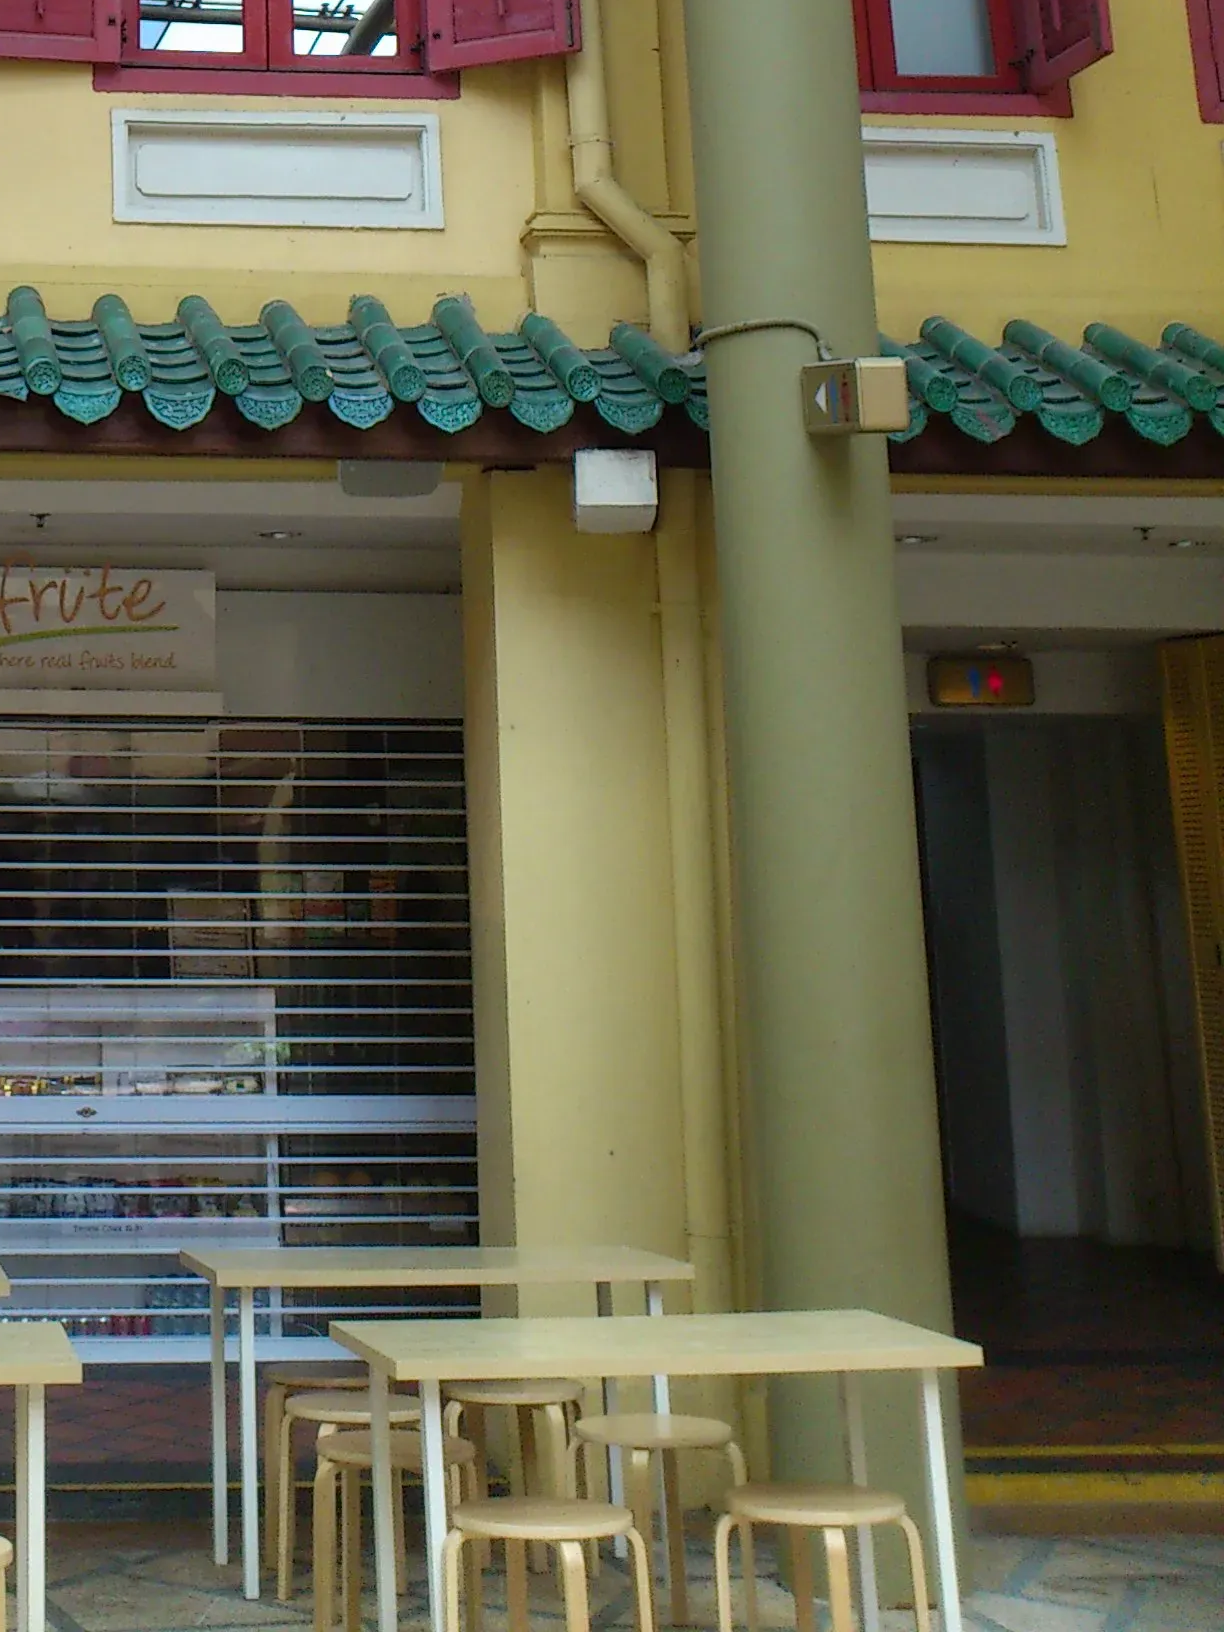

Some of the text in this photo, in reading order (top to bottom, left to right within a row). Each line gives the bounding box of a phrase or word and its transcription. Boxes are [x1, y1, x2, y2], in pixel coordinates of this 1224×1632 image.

[41, 652, 72, 669] real
[78, 650, 125, 671] fruits
[131, 652, 177, 670] blend
